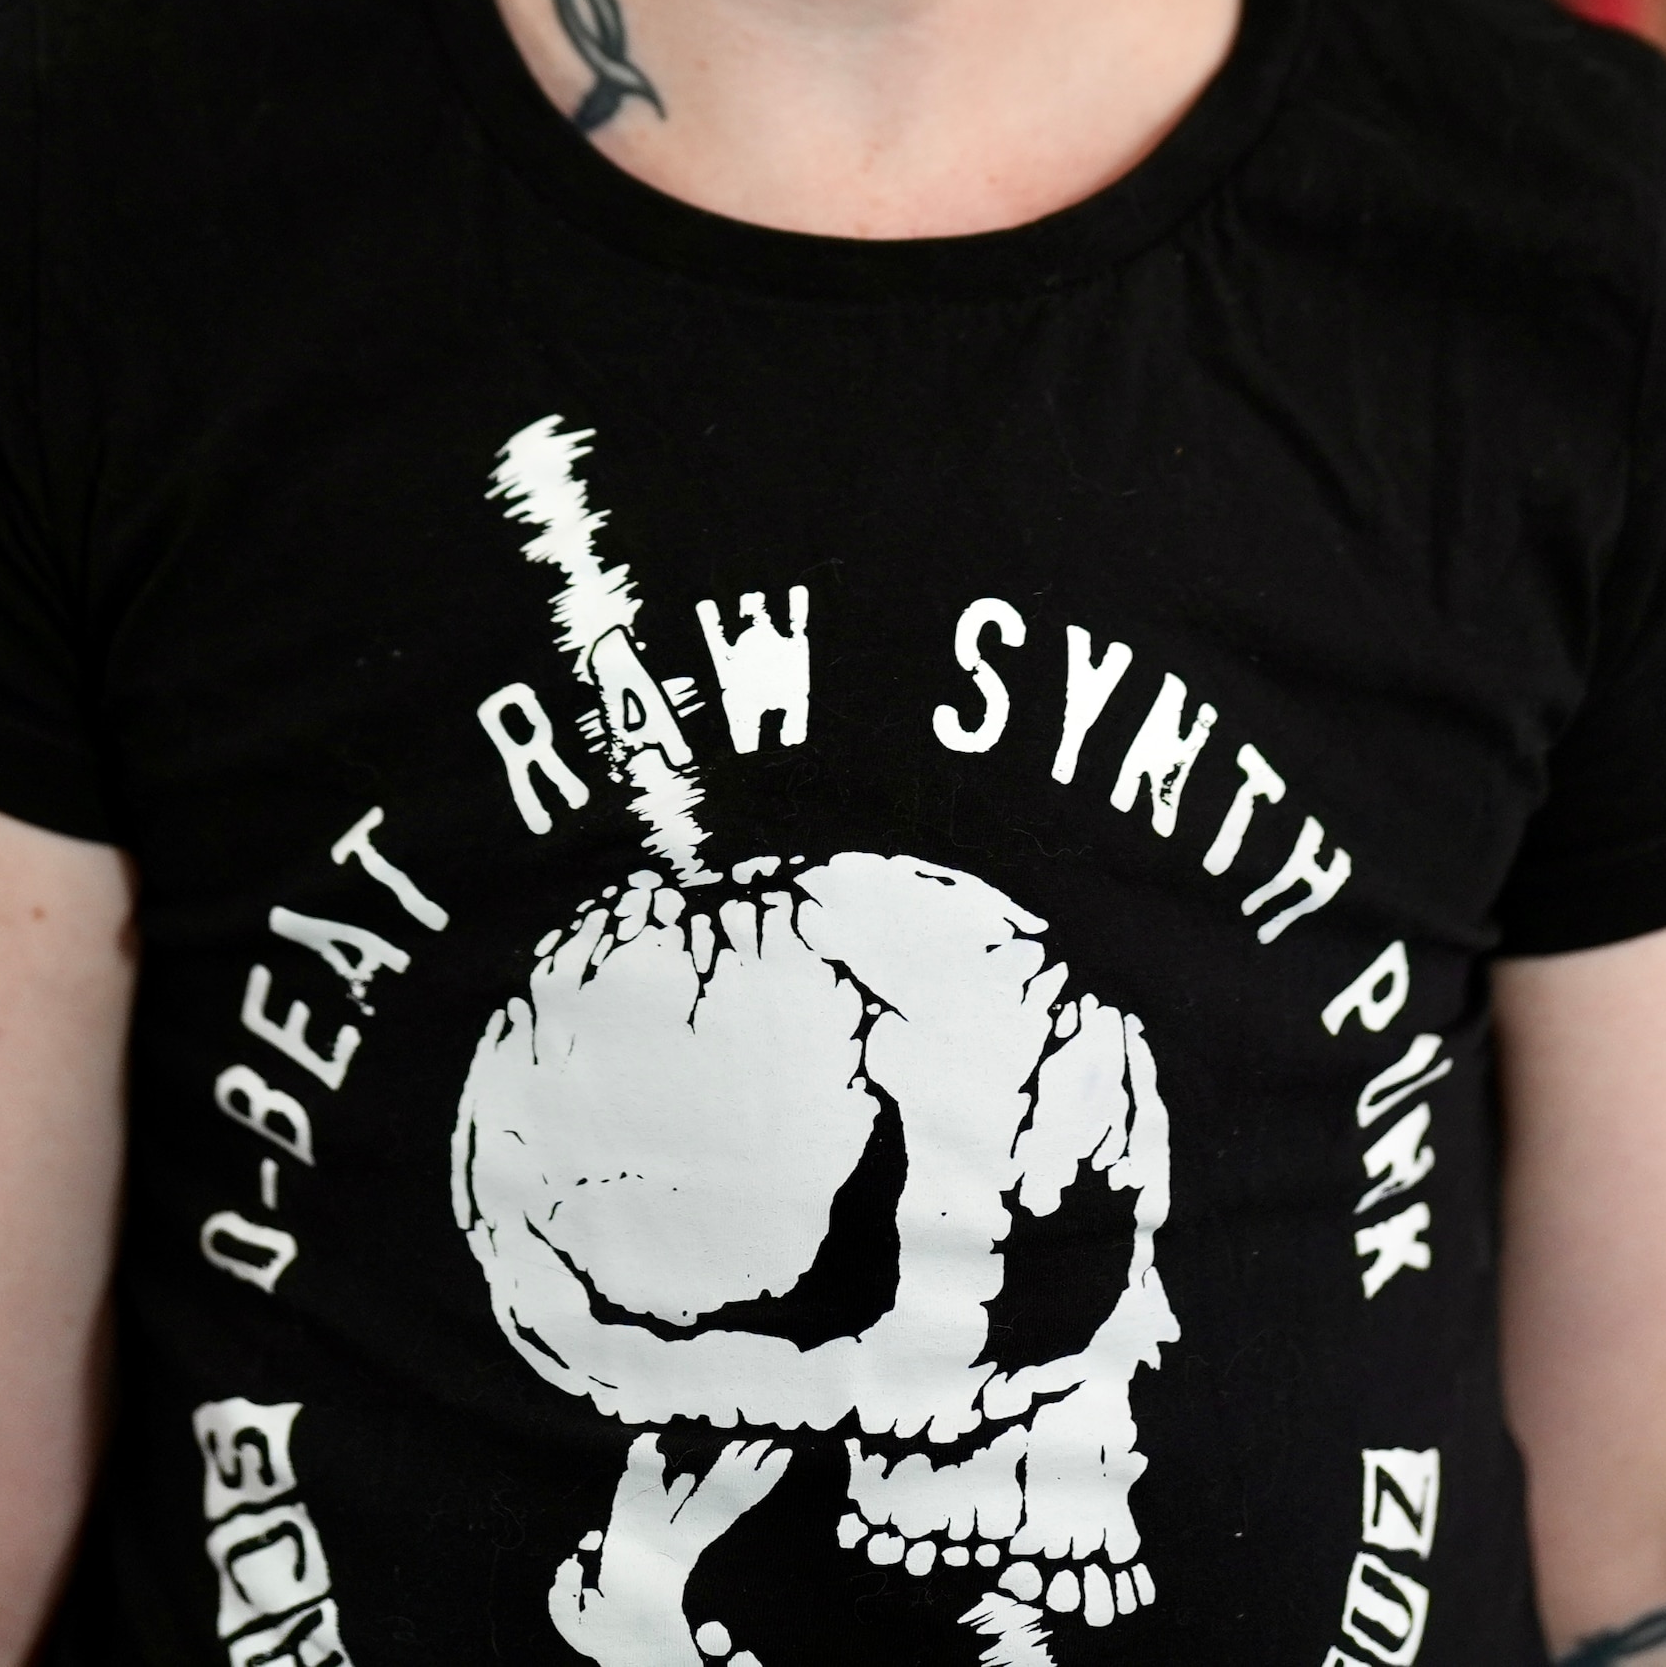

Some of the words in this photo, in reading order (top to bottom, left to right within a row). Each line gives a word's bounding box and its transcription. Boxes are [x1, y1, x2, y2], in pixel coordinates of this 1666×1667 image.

[203, 807, 448, 1291] D-BEAT
[477, 585, 810, 834] RAW
[933, 598, 1351, 944] SYNTH
[1322, 941, 1452, 1298] PUNK
